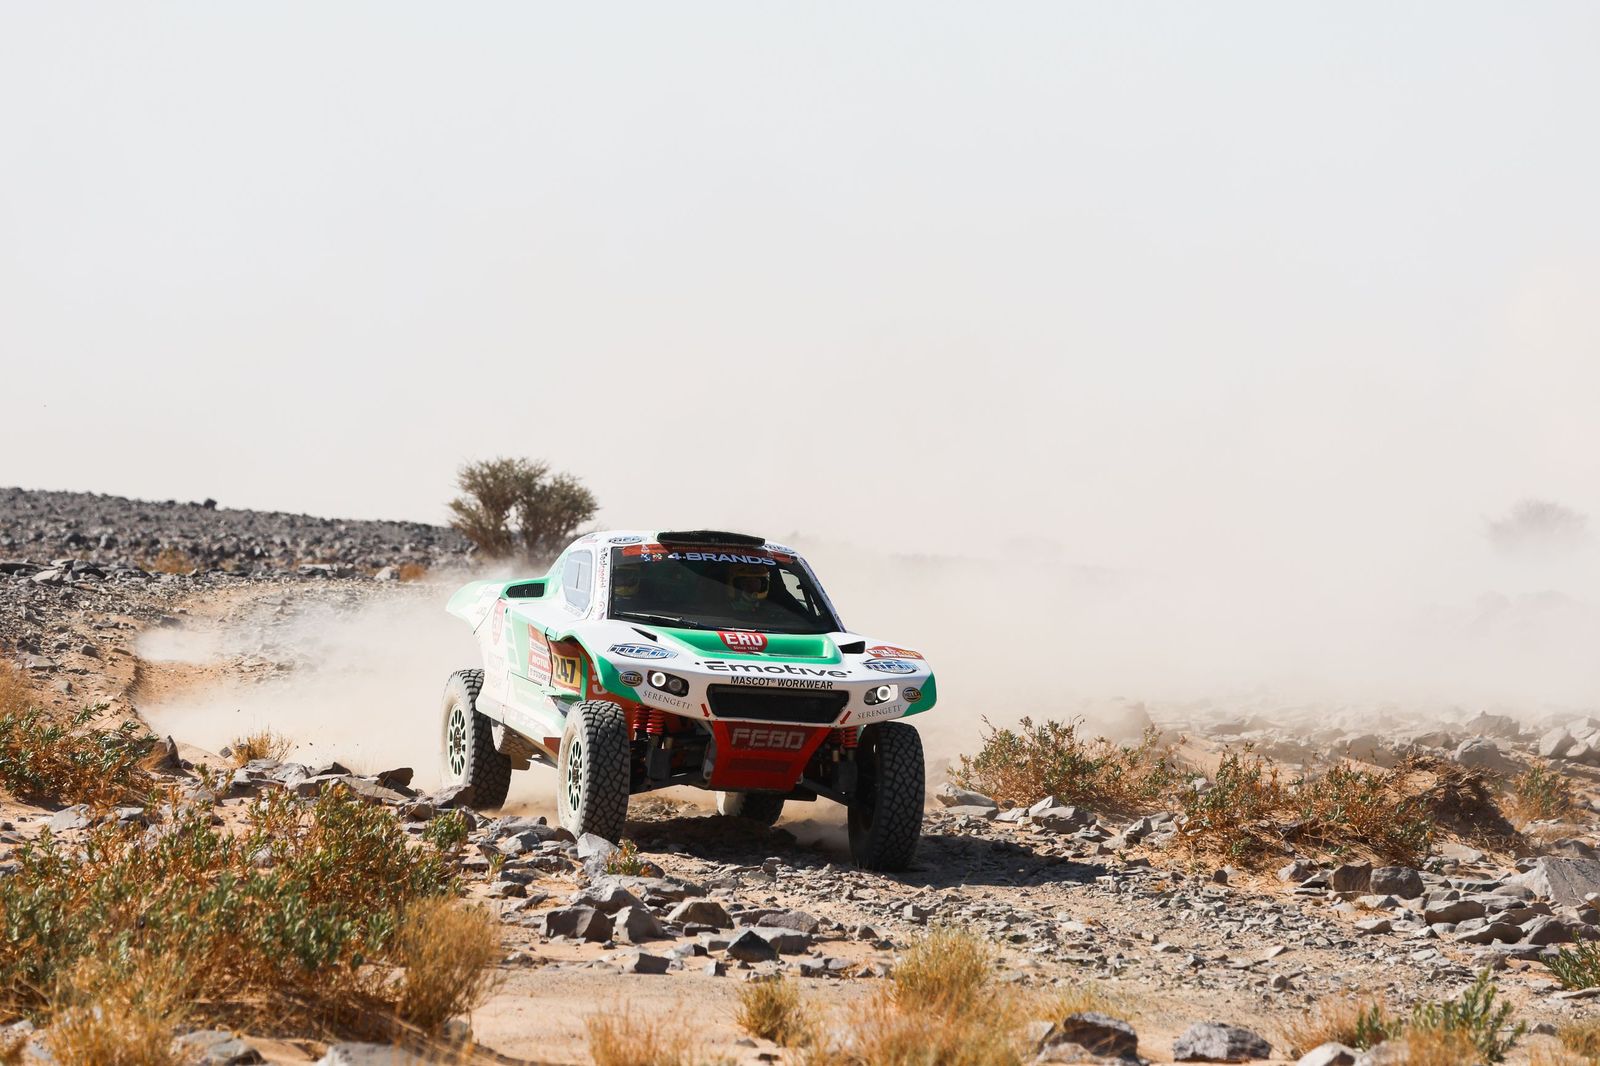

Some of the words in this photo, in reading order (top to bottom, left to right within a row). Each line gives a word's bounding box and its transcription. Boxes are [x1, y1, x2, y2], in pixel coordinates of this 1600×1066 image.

[723, 631, 763, 646] ERU
[552, 655, 576, 684] 247
[777, 678, 834, 690] WORKWEAR
